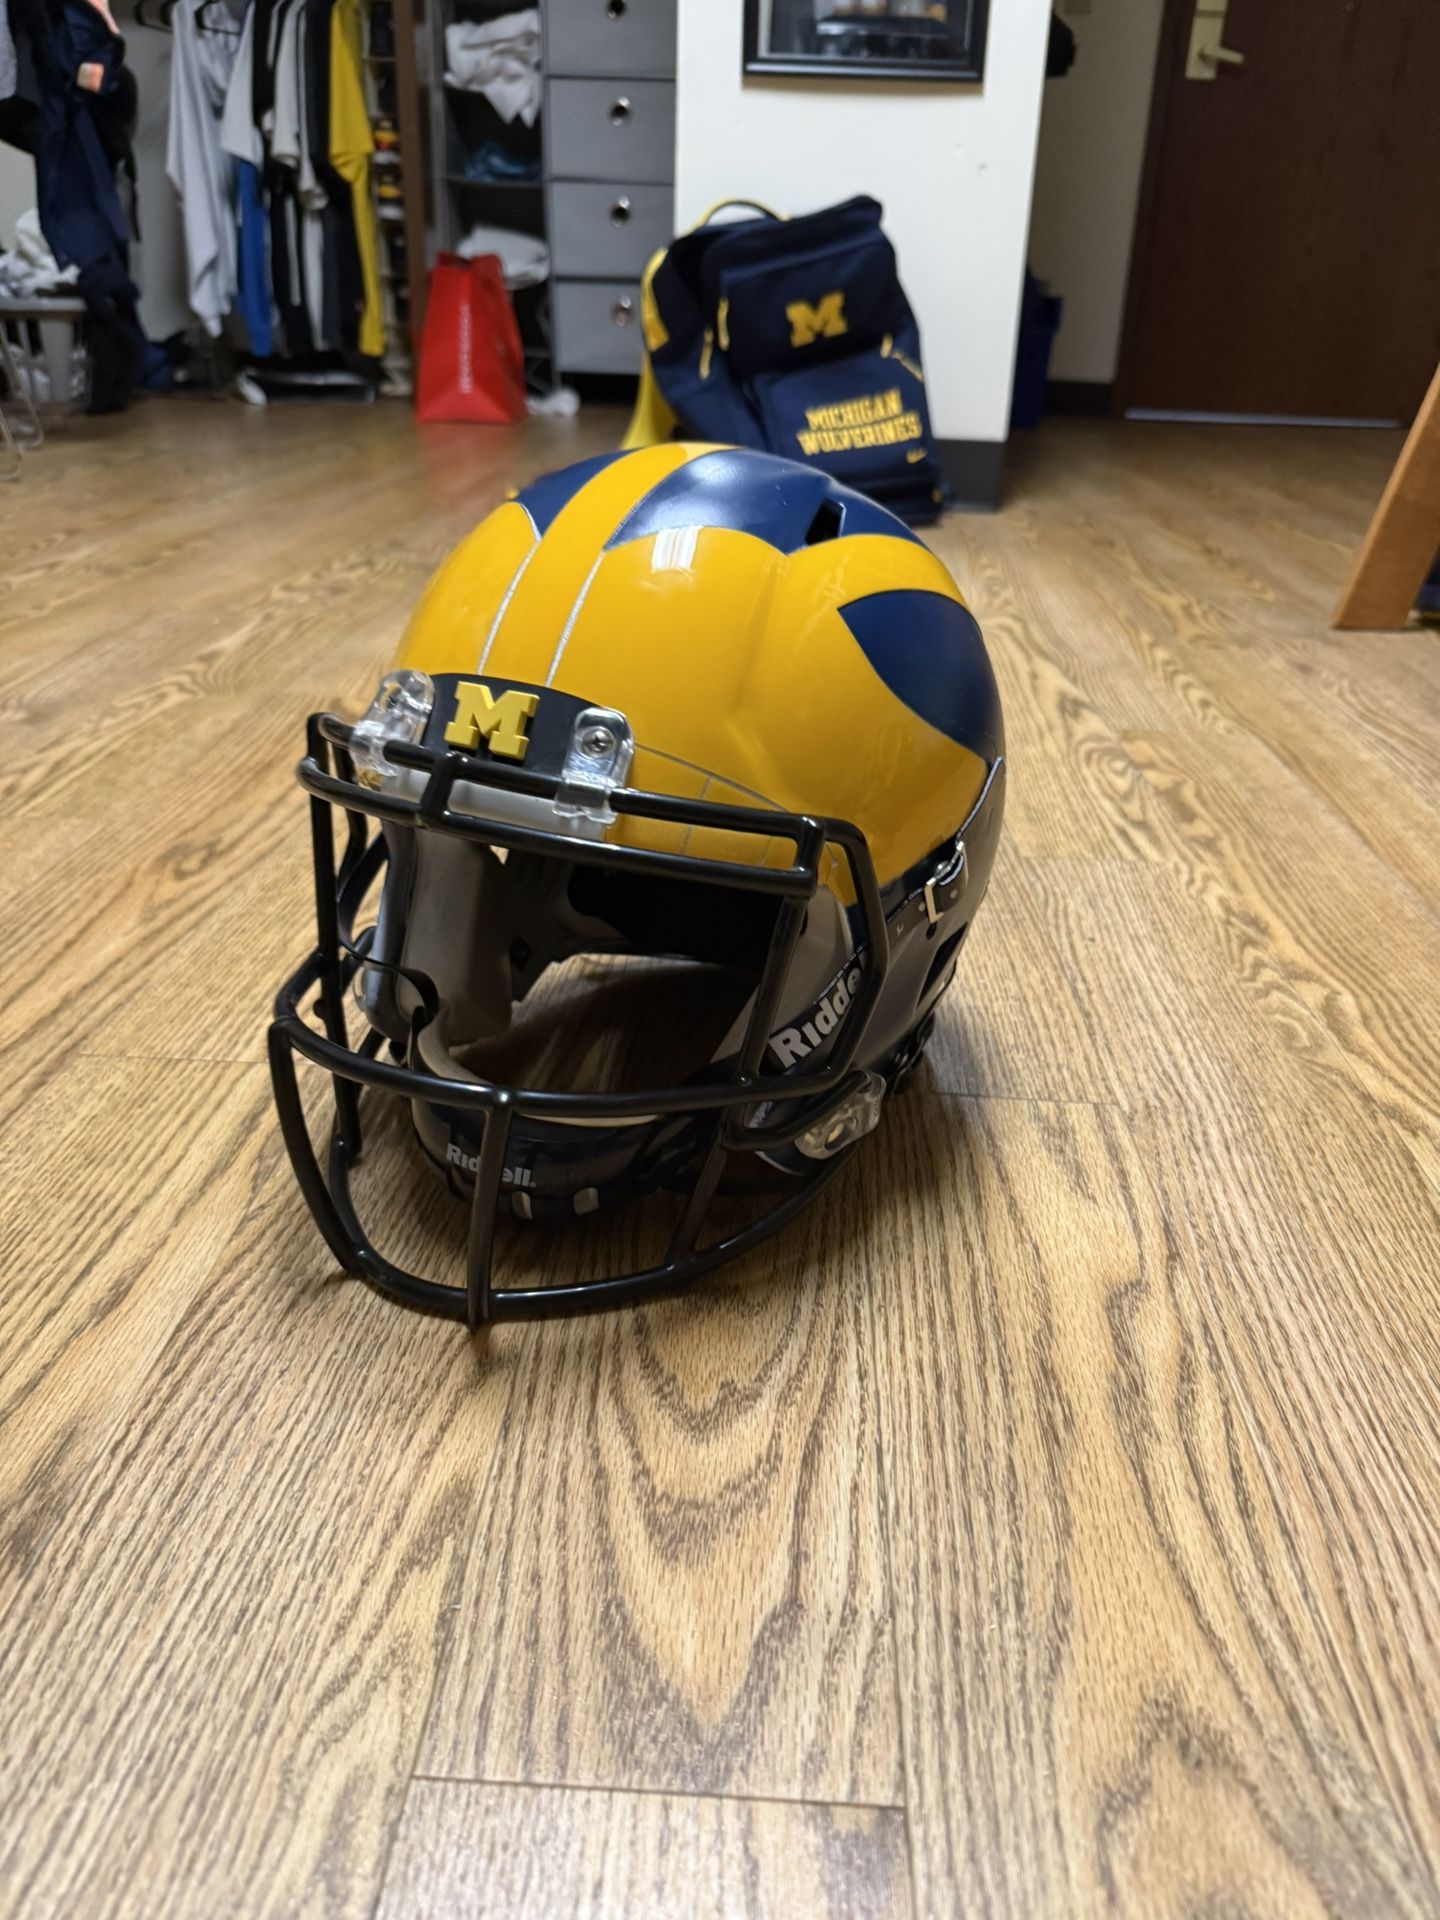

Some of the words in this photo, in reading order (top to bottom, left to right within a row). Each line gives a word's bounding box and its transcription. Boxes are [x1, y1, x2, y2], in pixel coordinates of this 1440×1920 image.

[785, 291, 848, 348] M
[804, 388, 903, 431] MICHIGAN
[796, 410, 923, 457] WOLVERINES
[444, 680, 540, 761] M
[446, 1143, 532, 1188] Ridell
